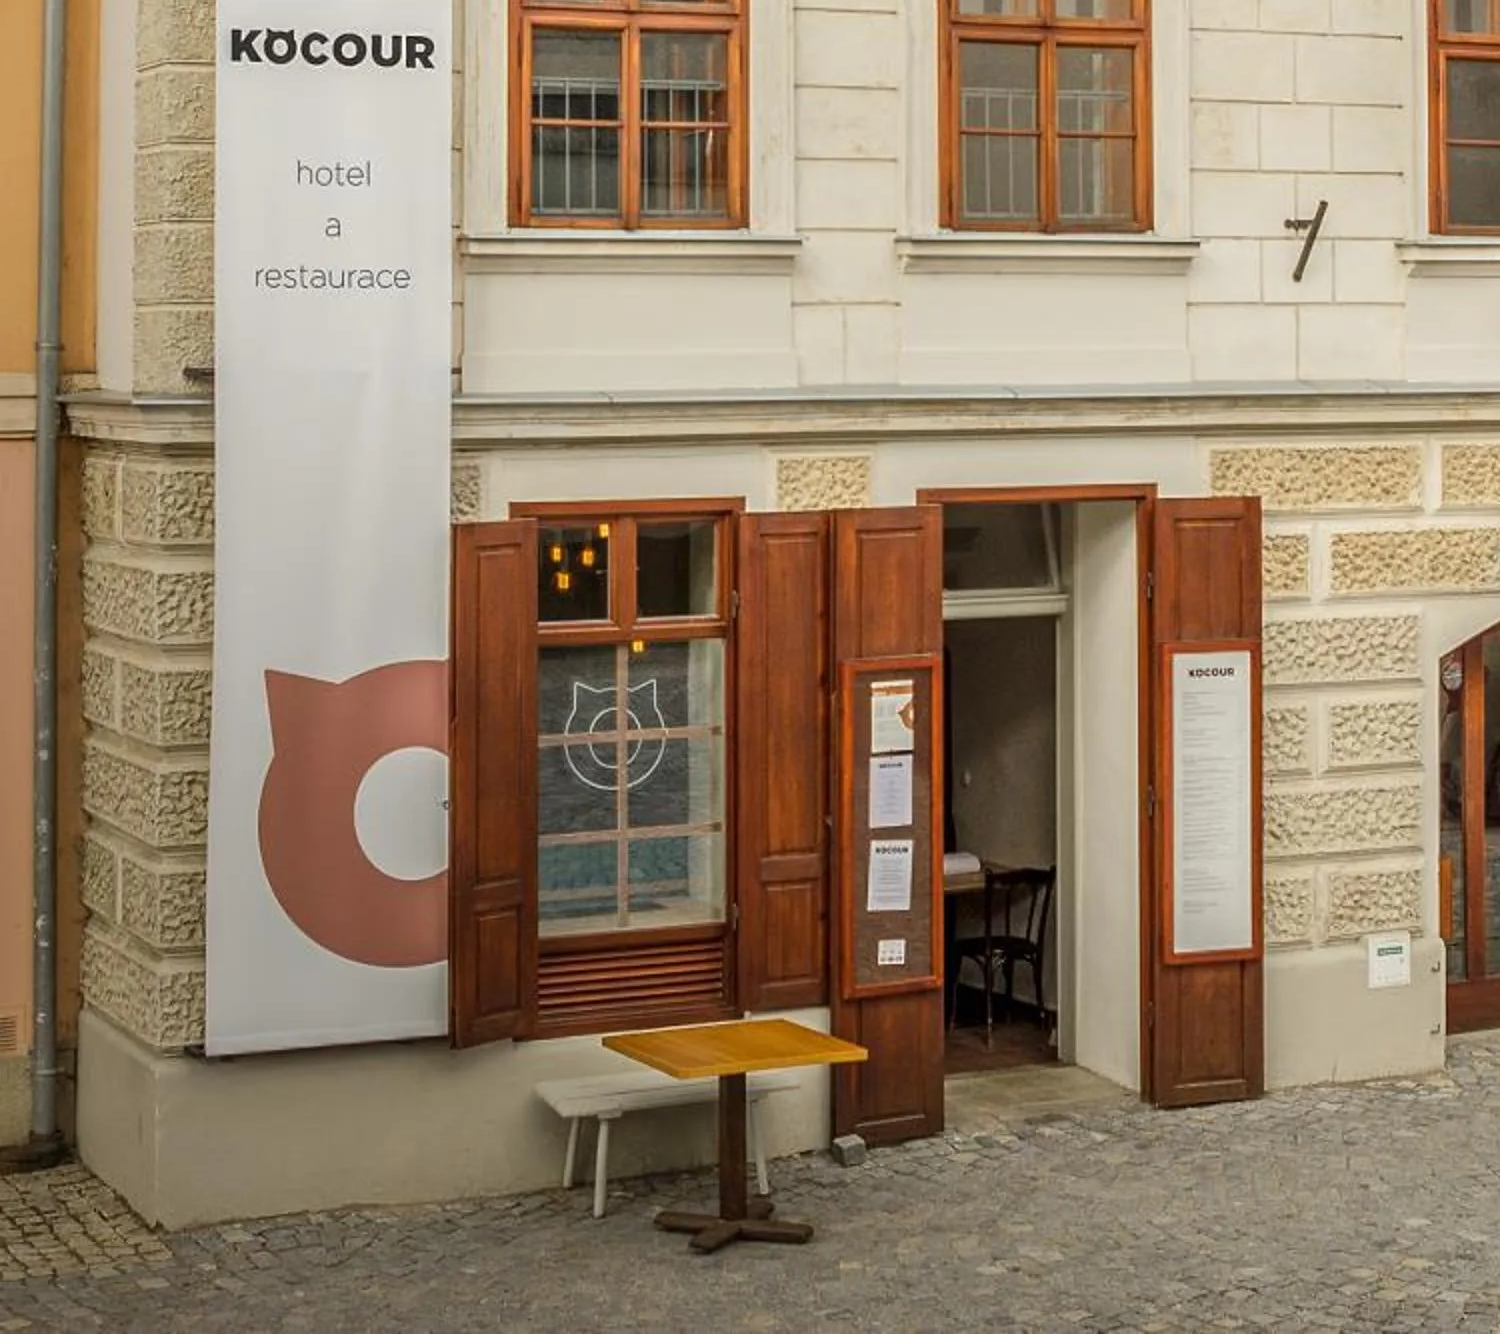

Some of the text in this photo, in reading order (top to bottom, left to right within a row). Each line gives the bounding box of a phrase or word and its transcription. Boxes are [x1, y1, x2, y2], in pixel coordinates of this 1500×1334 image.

[297, 160, 370, 187] hotel
[324, 217, 341, 237] a
[254, 264, 412, 290] restaurace
